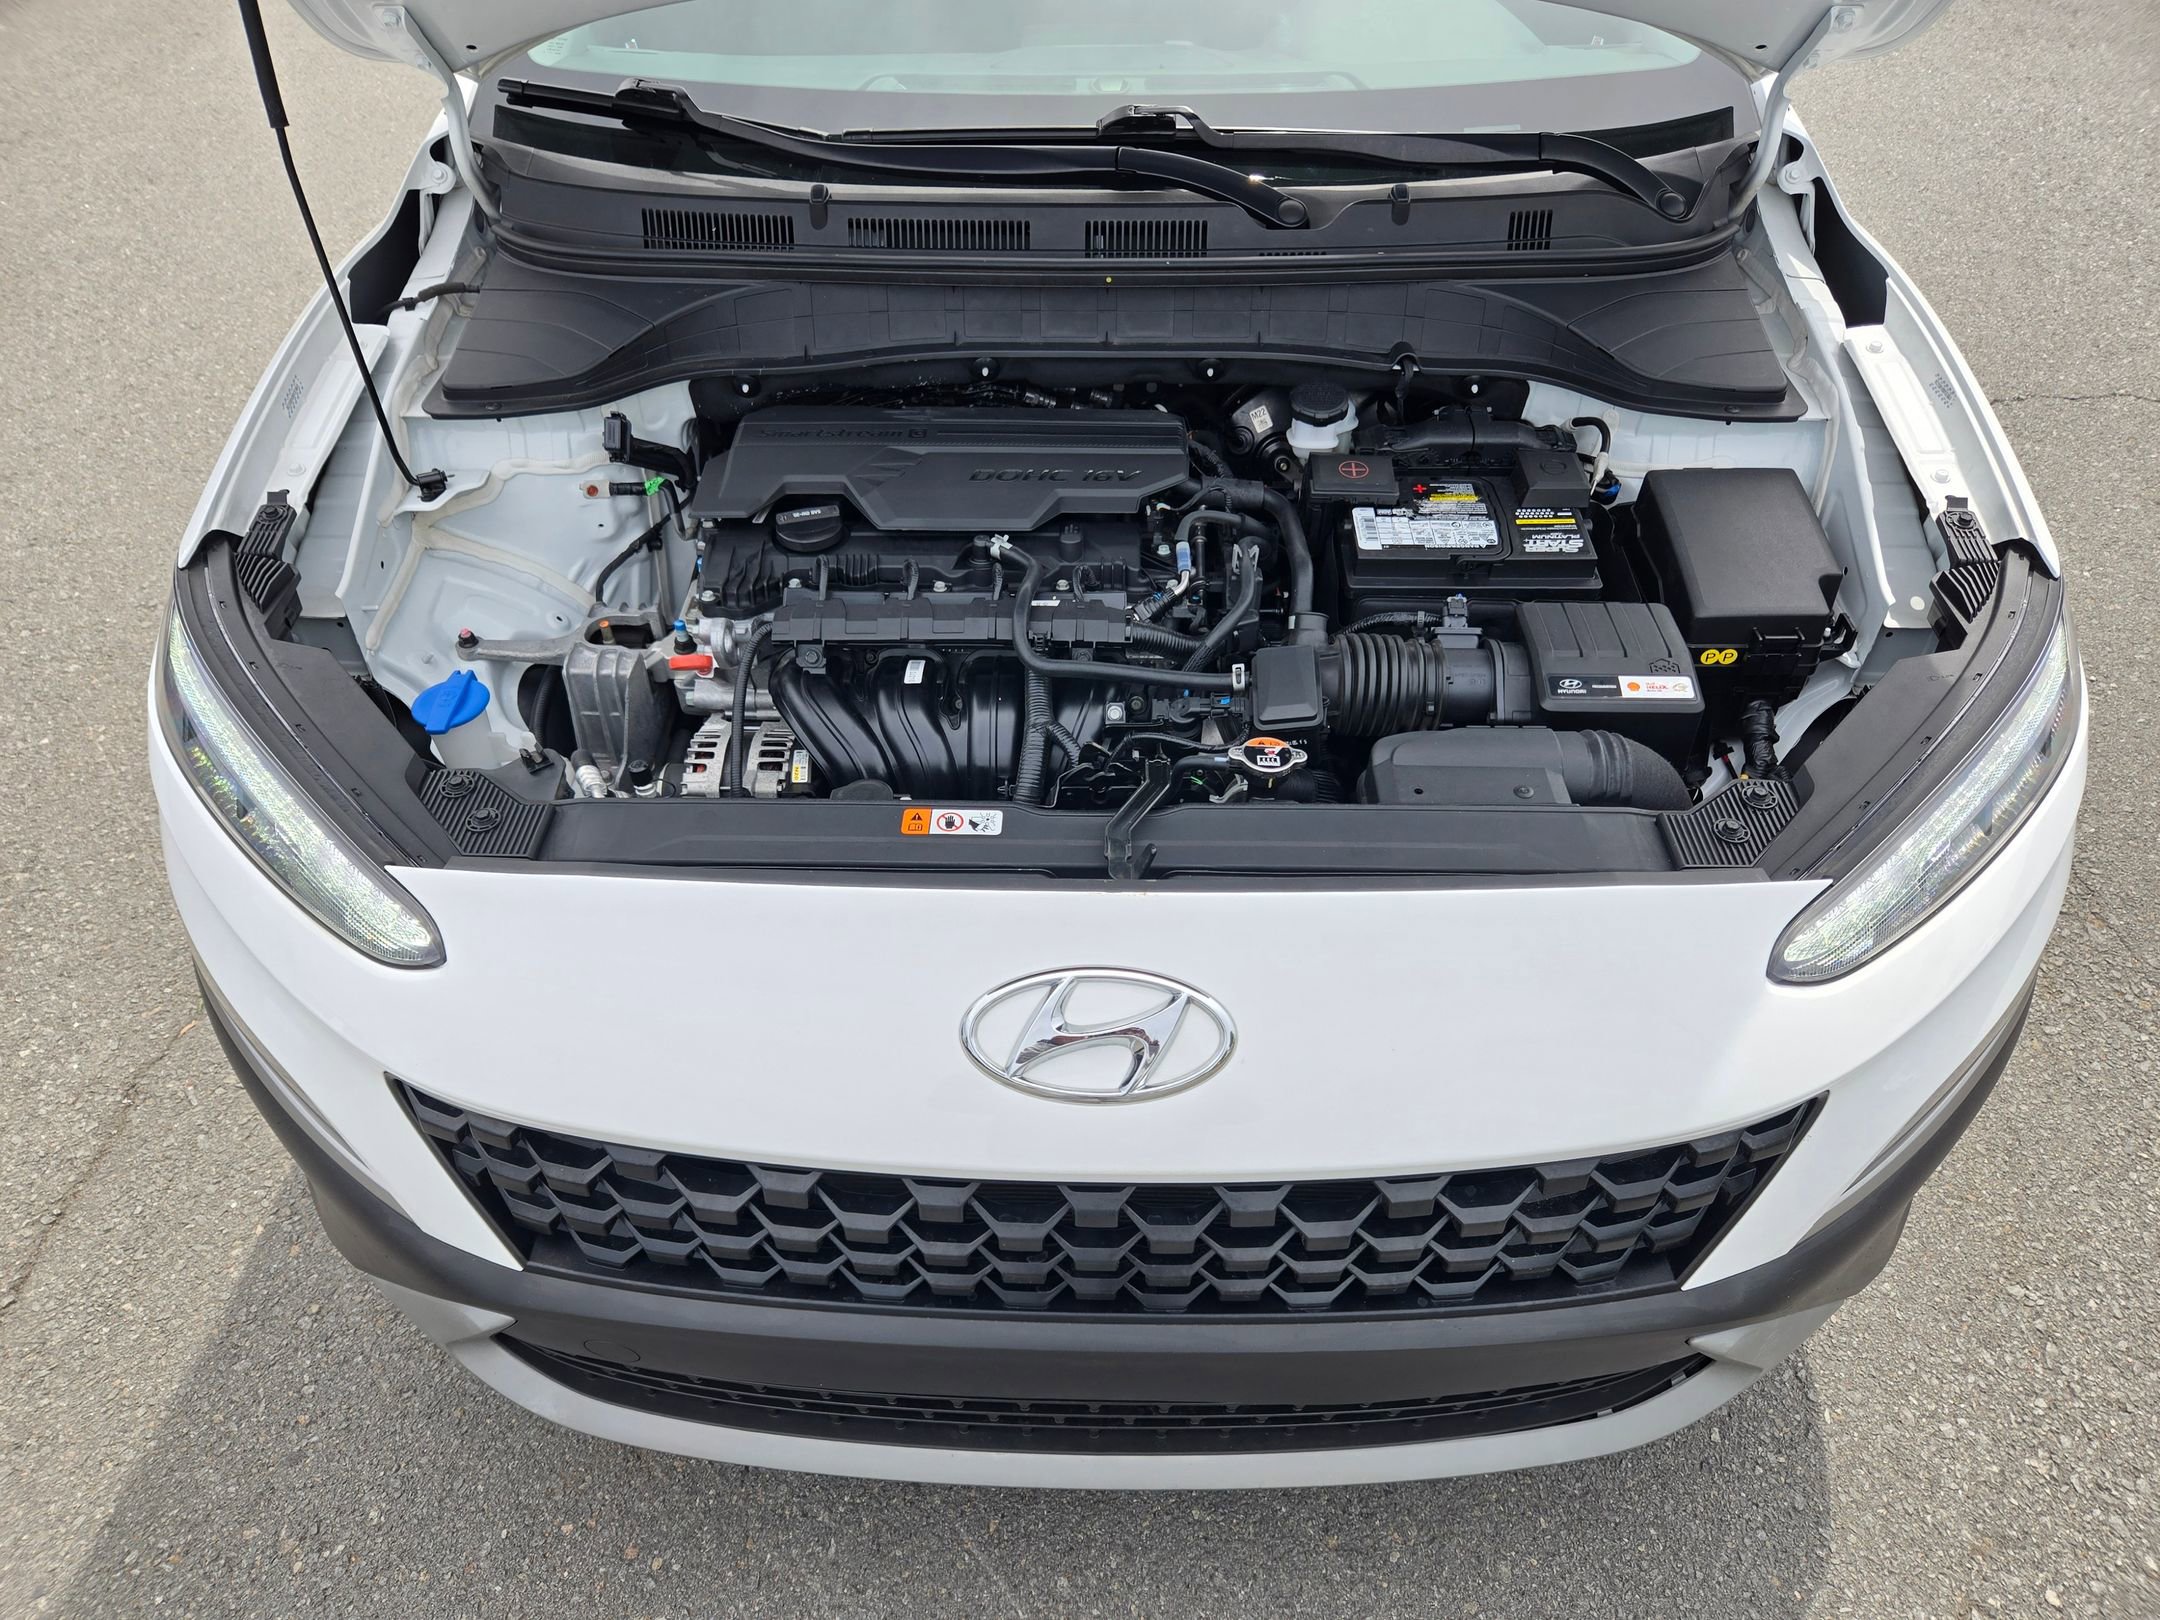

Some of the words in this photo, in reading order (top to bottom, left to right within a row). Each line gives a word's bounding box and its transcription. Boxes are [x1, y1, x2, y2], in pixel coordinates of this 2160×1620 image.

[1251, 408, 1267, 421] M22
[968, 468, 1074, 482] DOHC
[1082, 468, 1143, 482] 16V
[1523, 539, 1584, 548] START
